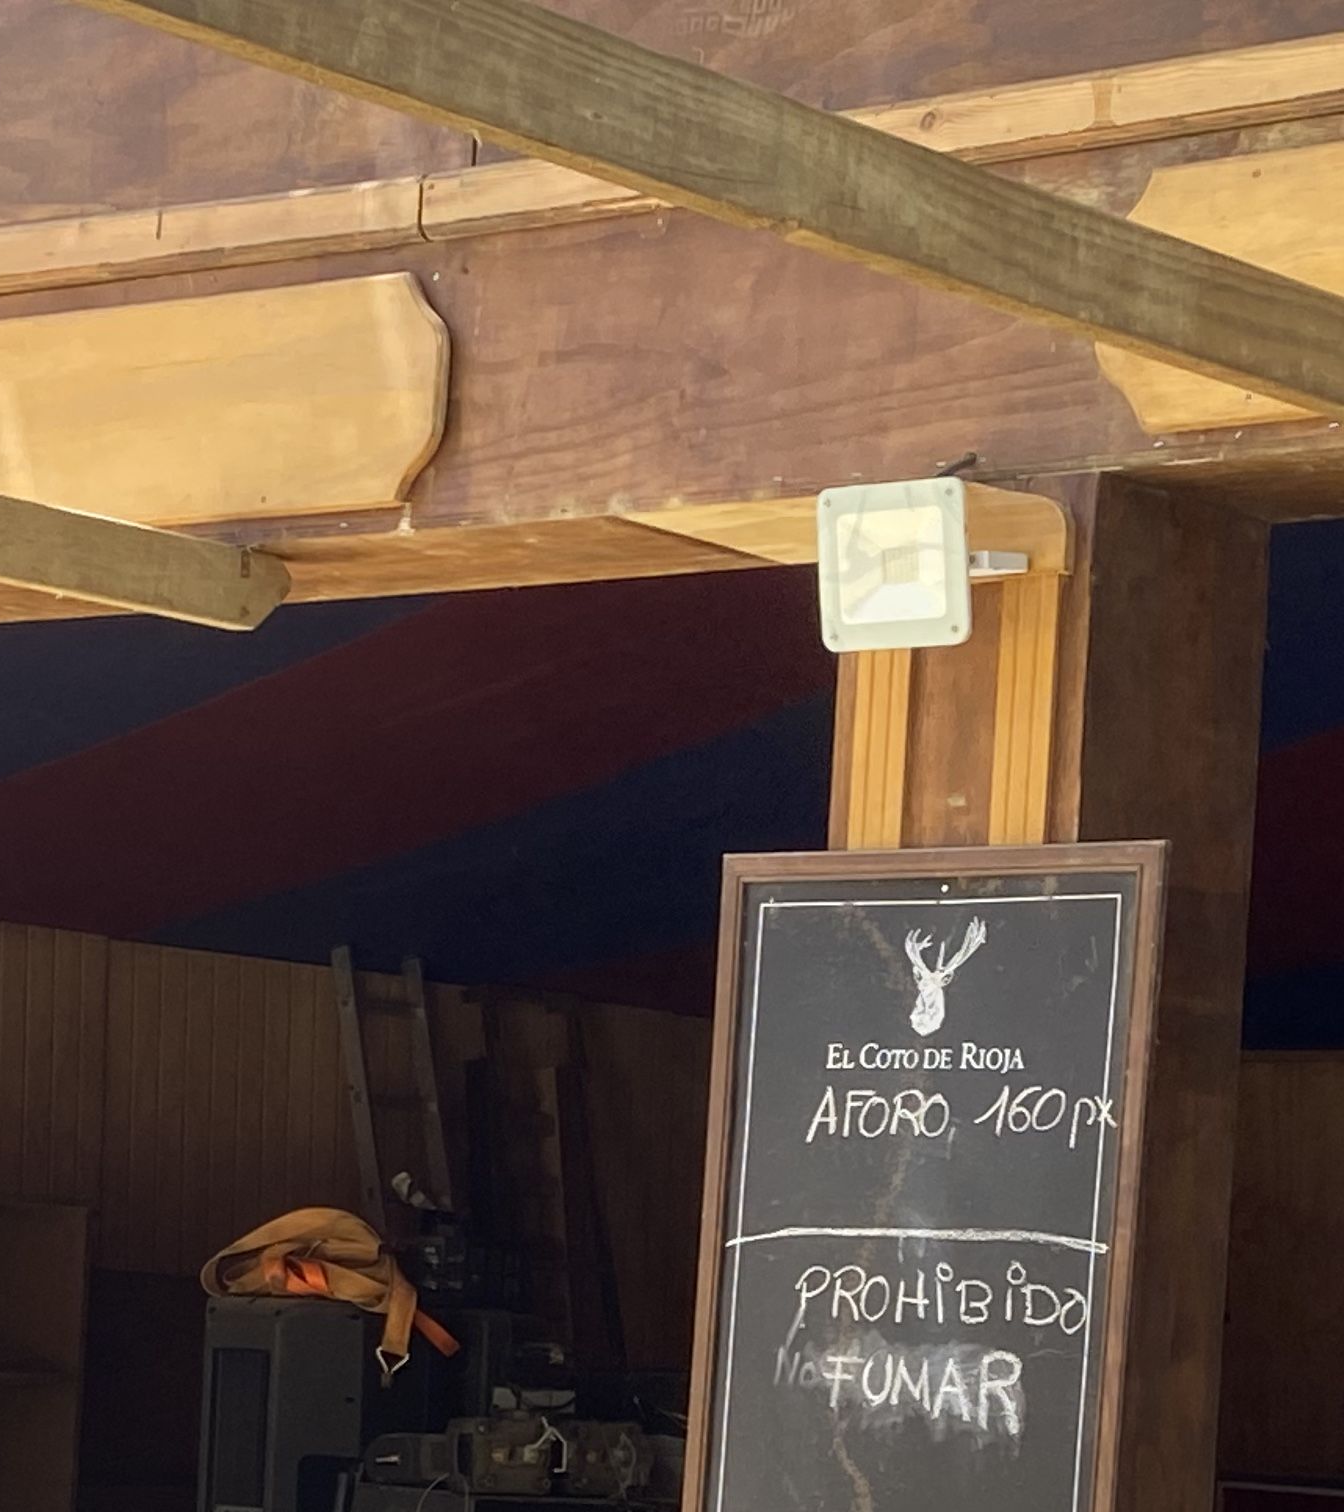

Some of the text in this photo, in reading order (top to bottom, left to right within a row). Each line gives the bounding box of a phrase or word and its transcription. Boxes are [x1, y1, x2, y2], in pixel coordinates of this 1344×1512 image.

[826, 1043, 1025, 1074] EL COTO DE RIOJA
[806, 1085, 950, 1143] AFORO
[822, 1350, 1023, 1435] FUMAR
